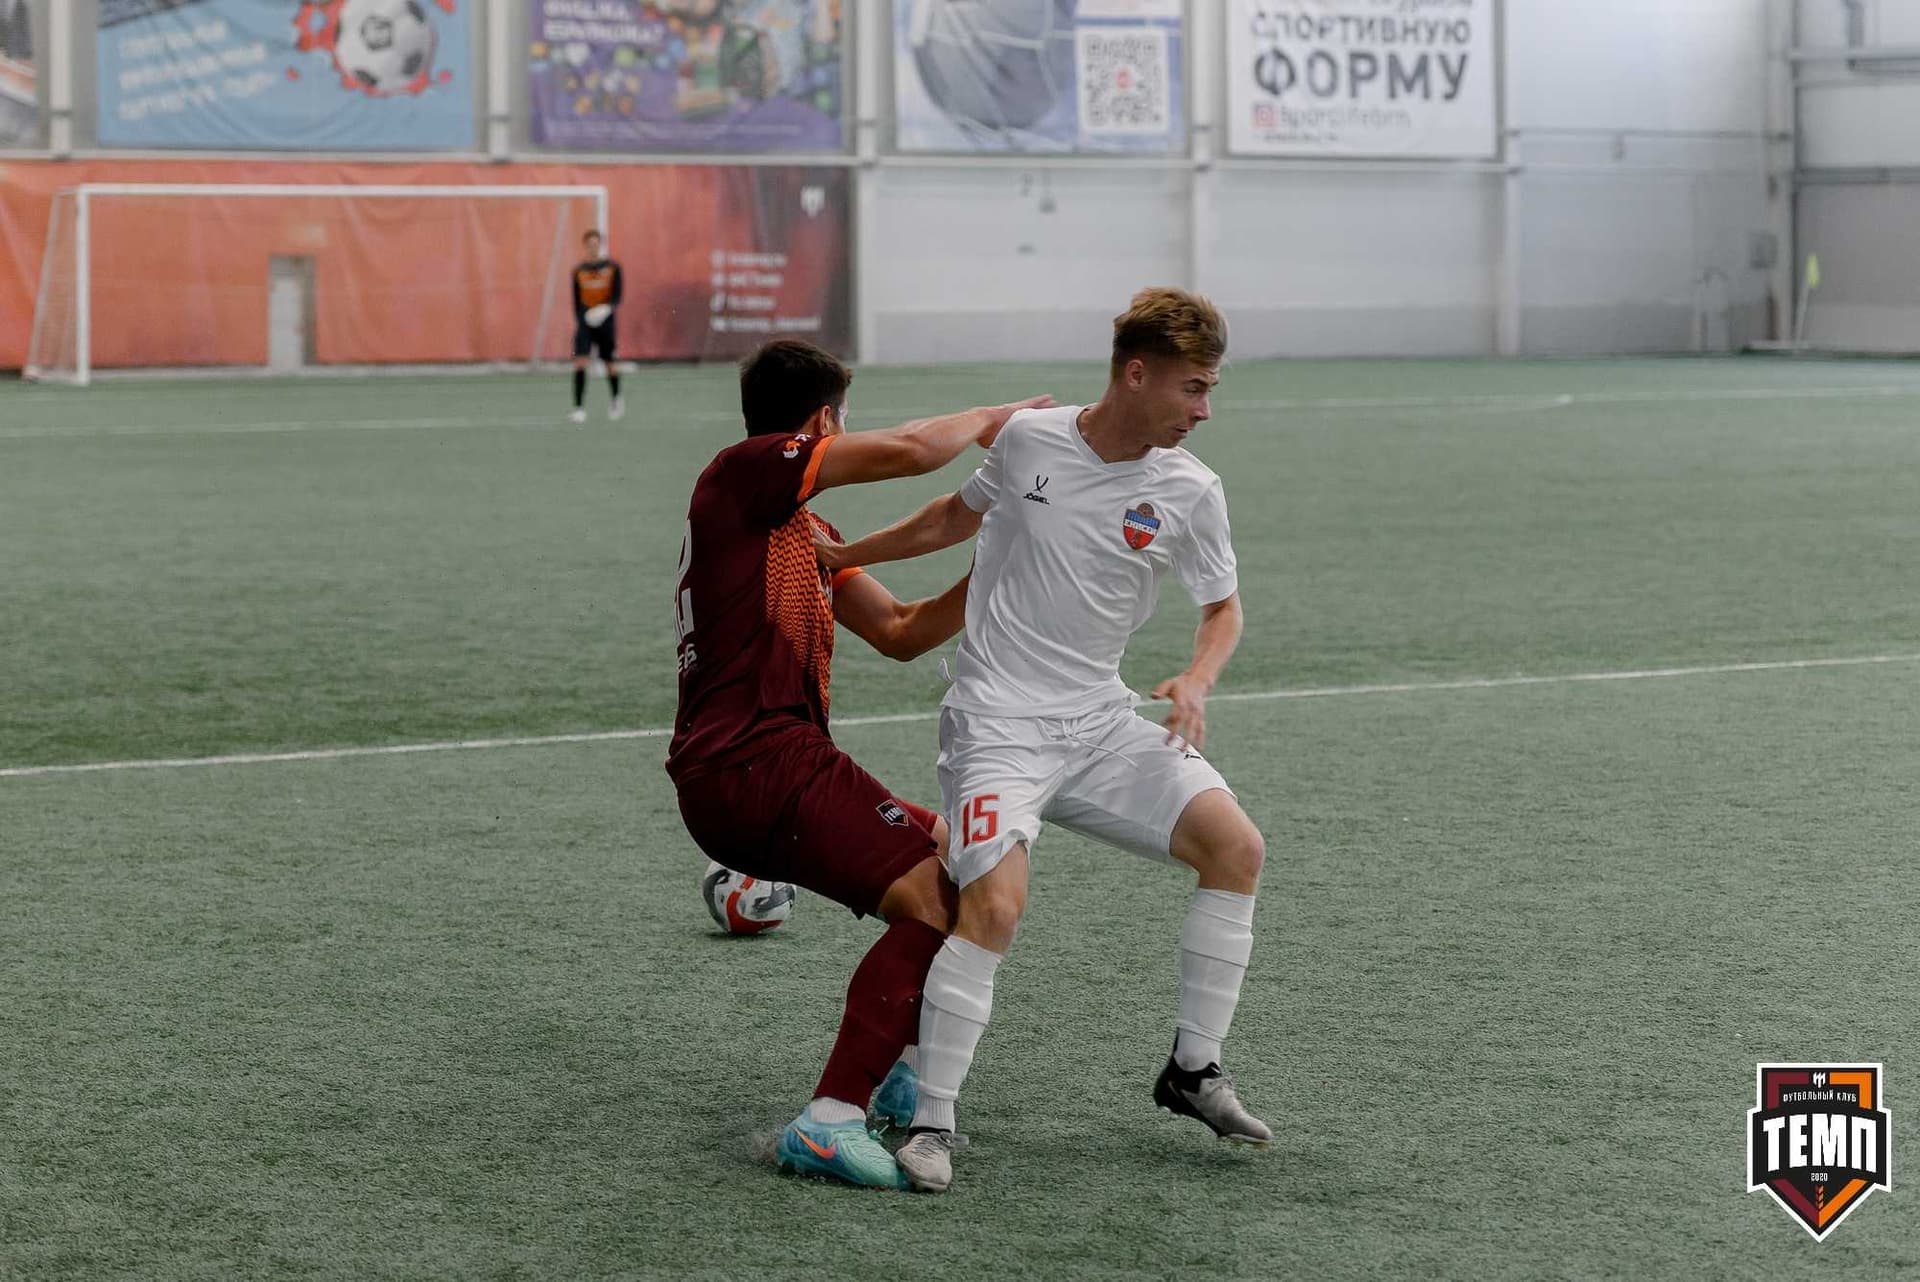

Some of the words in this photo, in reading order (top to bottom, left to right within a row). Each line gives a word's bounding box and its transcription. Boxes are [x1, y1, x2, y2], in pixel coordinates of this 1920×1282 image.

[1252, 12, 1471, 44] СПОРТИВНУЮ
[1254, 48, 1467, 101] ФОРМУ
[963, 793, 1000, 848] 15
